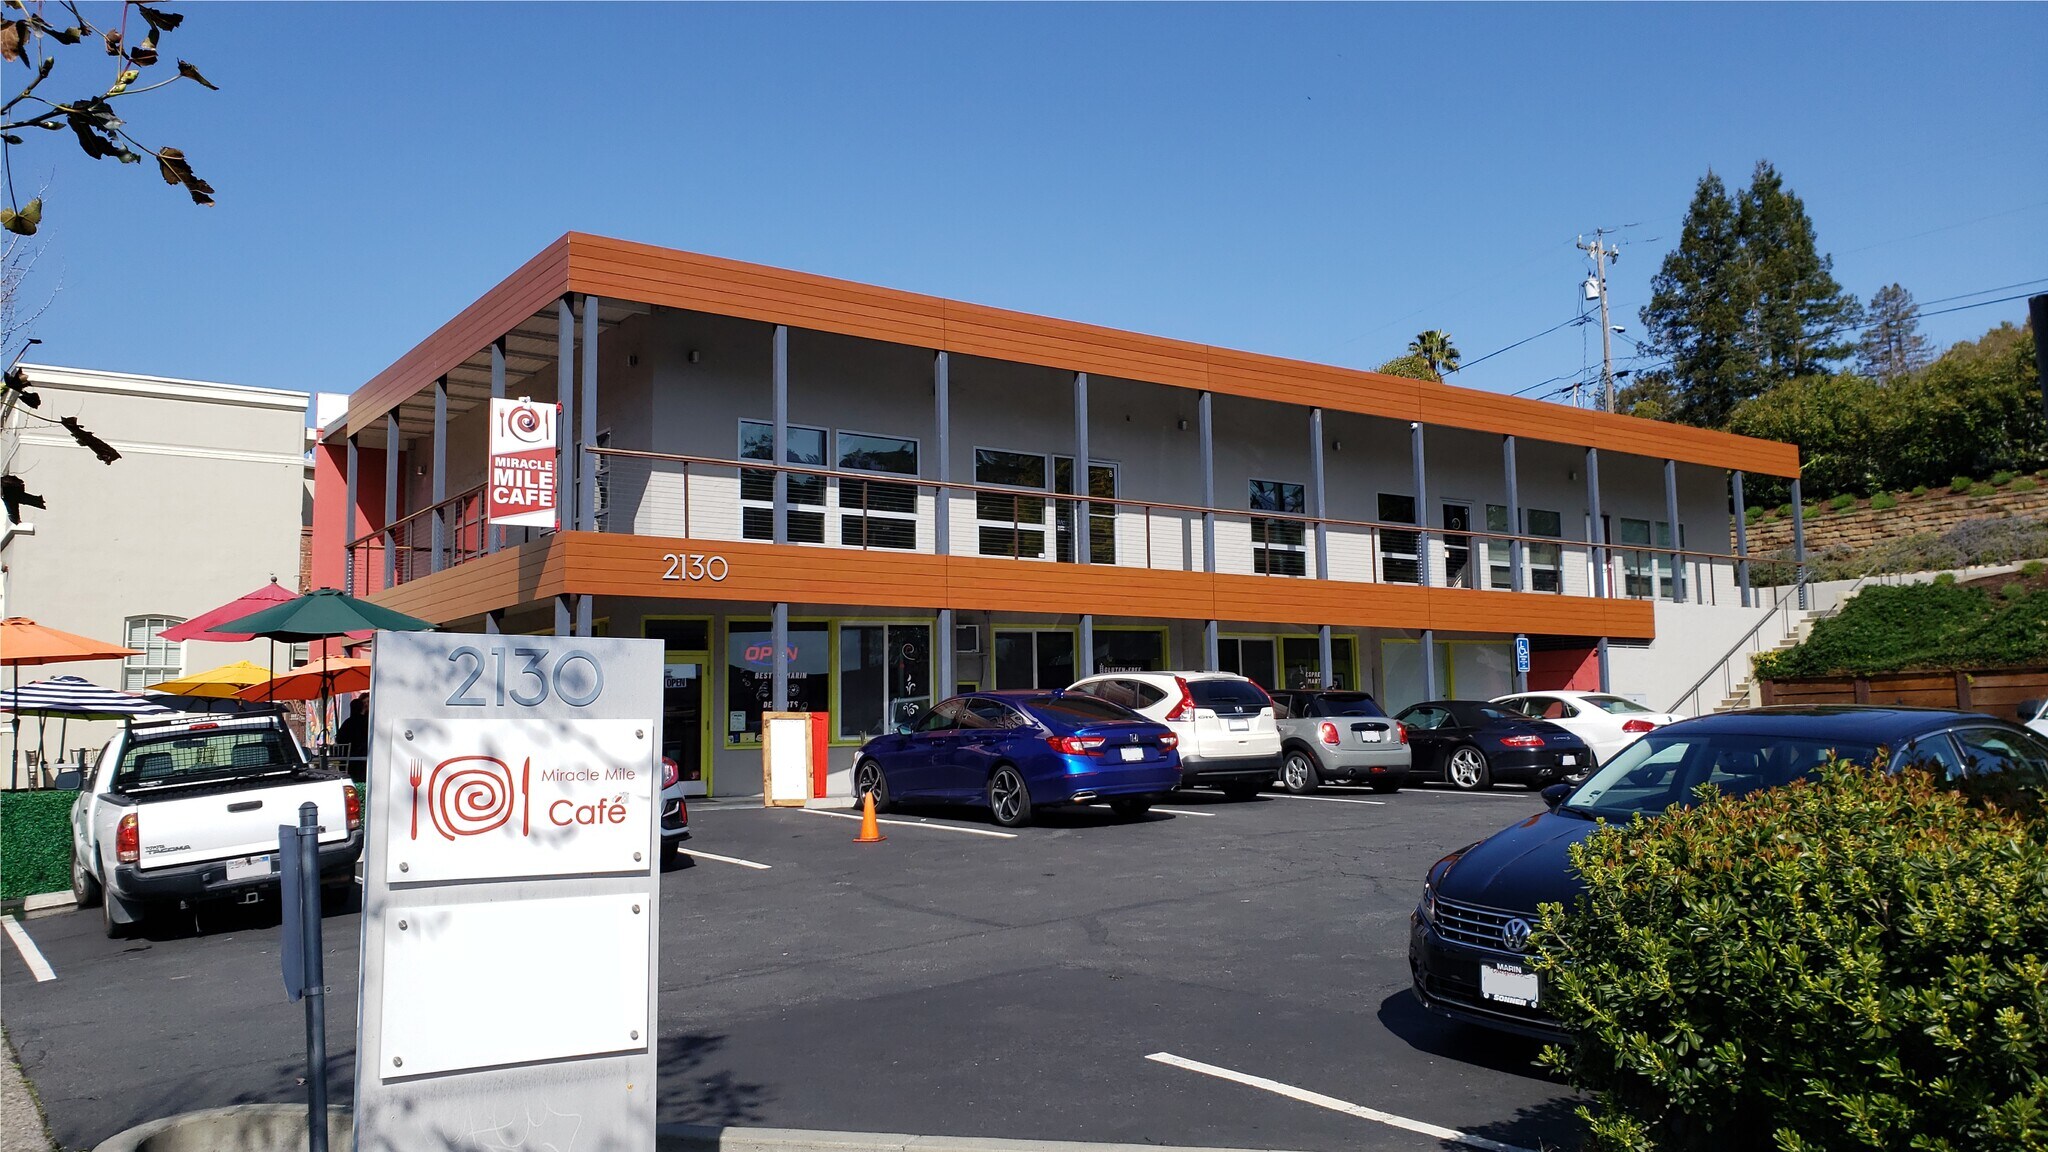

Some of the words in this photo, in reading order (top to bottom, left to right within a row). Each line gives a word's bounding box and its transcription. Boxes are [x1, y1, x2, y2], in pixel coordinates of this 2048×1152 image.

[495, 457, 553, 471] MIRACLE
[494, 468, 553, 490] MILE
[493, 487, 553, 507] CAFE
[662, 553, 729, 582] 2130
[744, 646, 799, 661] OPN
[445, 646, 604, 707] 2130
[666, 678, 686, 687] OPEN
[754, 672, 773, 680] BEST
[763, 700, 799, 709] DERTS
[541, 768, 600, 782] Miracle
[605, 767, 636, 781] Mile
[549, 795, 627, 827] Café
[145, 844, 191, 855] TACOMA
[1497, 963, 1522, 974] MARIN
